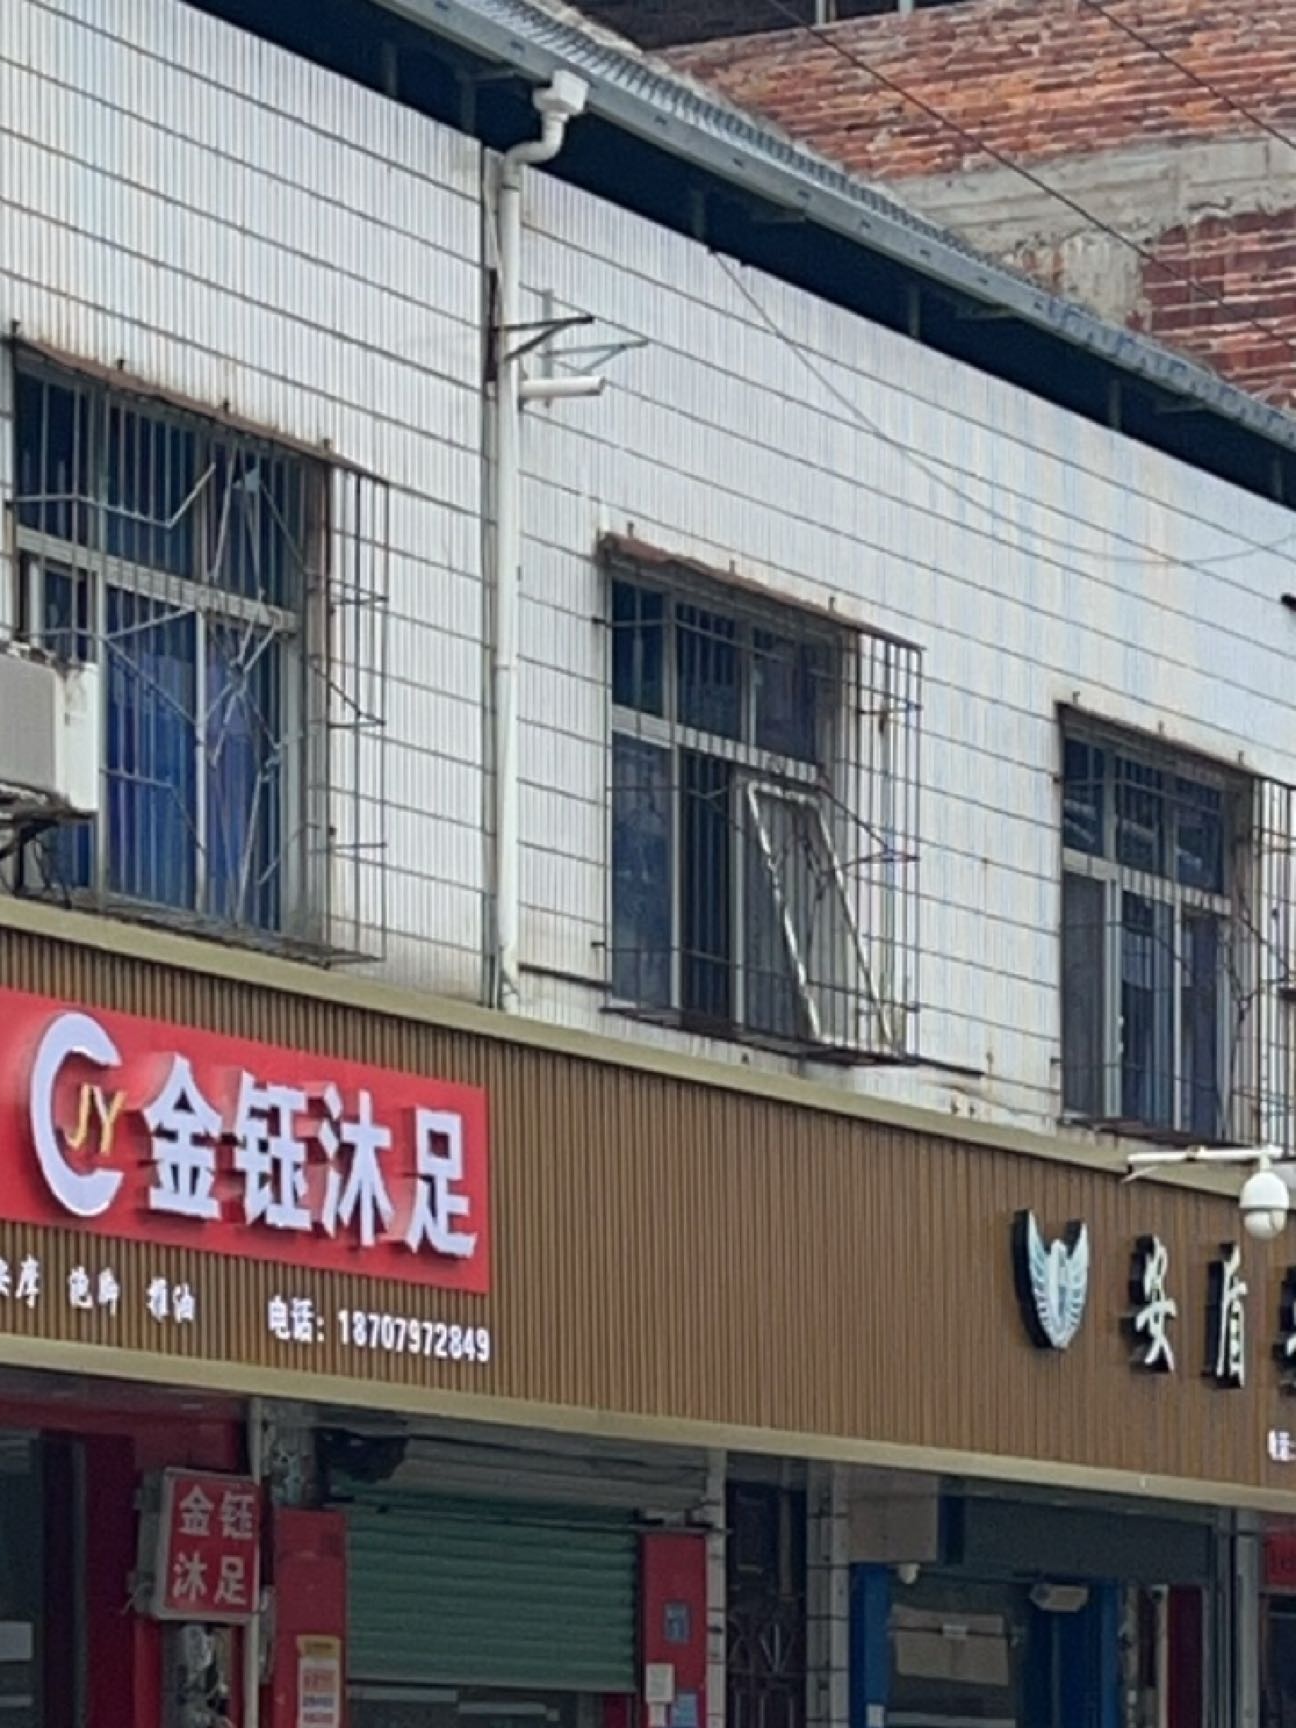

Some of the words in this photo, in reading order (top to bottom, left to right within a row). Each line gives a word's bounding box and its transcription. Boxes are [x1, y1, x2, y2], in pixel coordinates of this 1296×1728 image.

[64, 1083, 126, 1156] JY
[143, 1052, 479, 1258] 金钰沐足
[1135, 1233, 1296, 1388] 安盾
[178, 1484, 255, 1540] 金钰
[172, 1550, 247, 1606] 沐足
